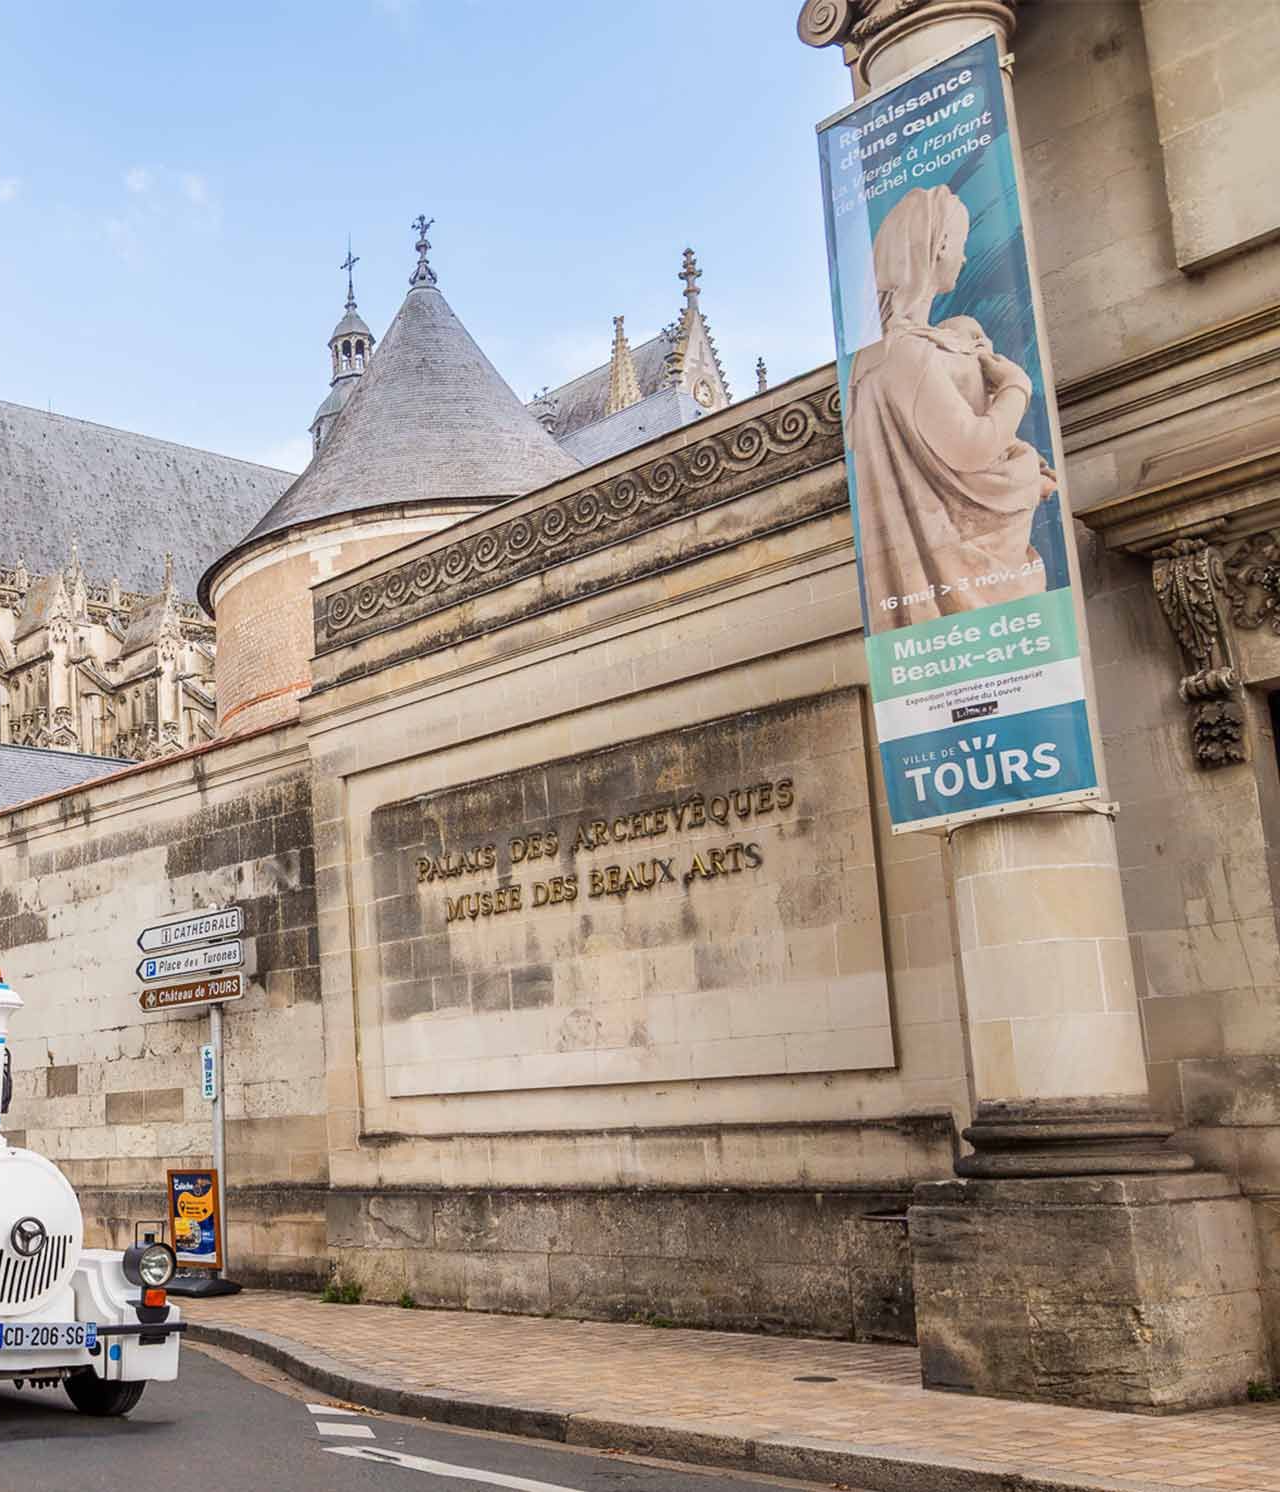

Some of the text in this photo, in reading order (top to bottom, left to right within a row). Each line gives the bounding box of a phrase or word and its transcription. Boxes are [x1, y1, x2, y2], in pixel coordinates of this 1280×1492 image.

[839, 69, 972, 149] Renaissance
[840, 92, 975, 171] d'une œuvre
[853, 155, 902, 188] Vierge
[906, 145, 918, 161] à
[923, 111, 992, 155] l'Enfant
[858, 170, 908, 201] Michel
[912, 134, 992, 177] Colombe
[879, 596, 898, 611] 16
[902, 585, 936, 606] mai
[975, 570, 1016, 588] nov.
[890, 634, 1051, 686] Beaux-arts
[893, 612, 1042, 661] Musée des
[905, 690, 945, 706] Exposition
[985, 680, 995, 689] en
[996, 670, 1043, 687] partenariat
[953, 692, 979, 705] musée
[981, 690, 992, 699] du
[993, 685, 1022, 698] Louvre
[902, 747, 956, 766] VILLE DE
[905, 742, 1061, 802] TOURS
[416, 778, 796, 884] PALAIS DES ARCHEVÊQUES
[532, 873, 578, 908] DES
[587, 856, 677, 898] BEAUX
[683, 842, 764, 882] ARTS
[158, 961, 182, 973] Place
[184, 958, 198, 967] des
[203, 949, 237, 965] Turones
[195, 986, 205, 998] de
[208, 979, 238, 995] TOURS
[4, 1326, 84, 1346] CD-206-SG
